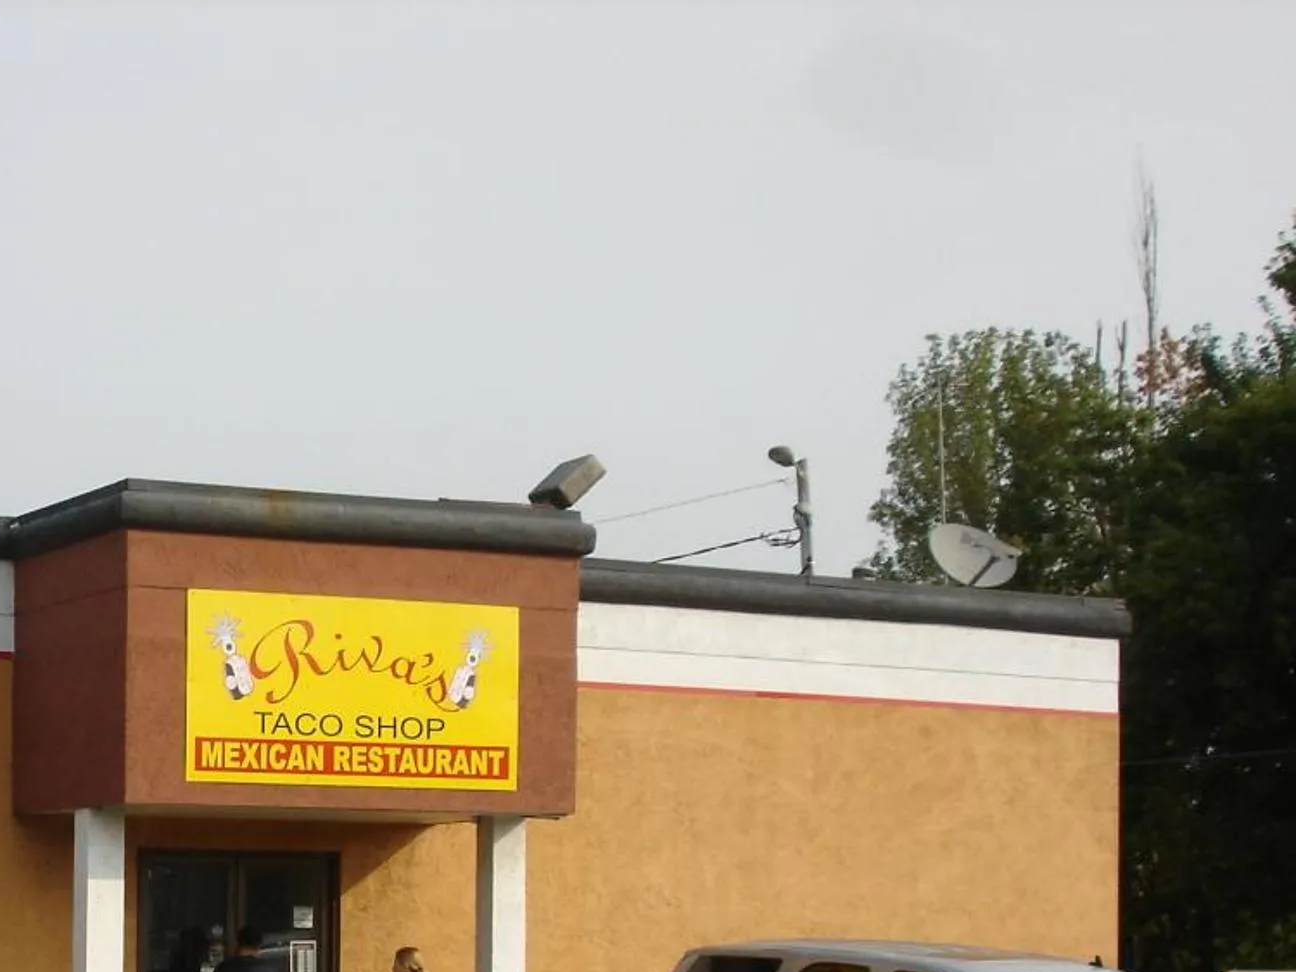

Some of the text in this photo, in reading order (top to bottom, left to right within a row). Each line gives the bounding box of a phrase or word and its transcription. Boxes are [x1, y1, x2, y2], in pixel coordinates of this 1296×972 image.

[248, 619, 461, 712] Riva's
[254, 711, 446, 740] TACO SHOP
[201, 741, 505, 777] MEXICAN RESTAURANT
